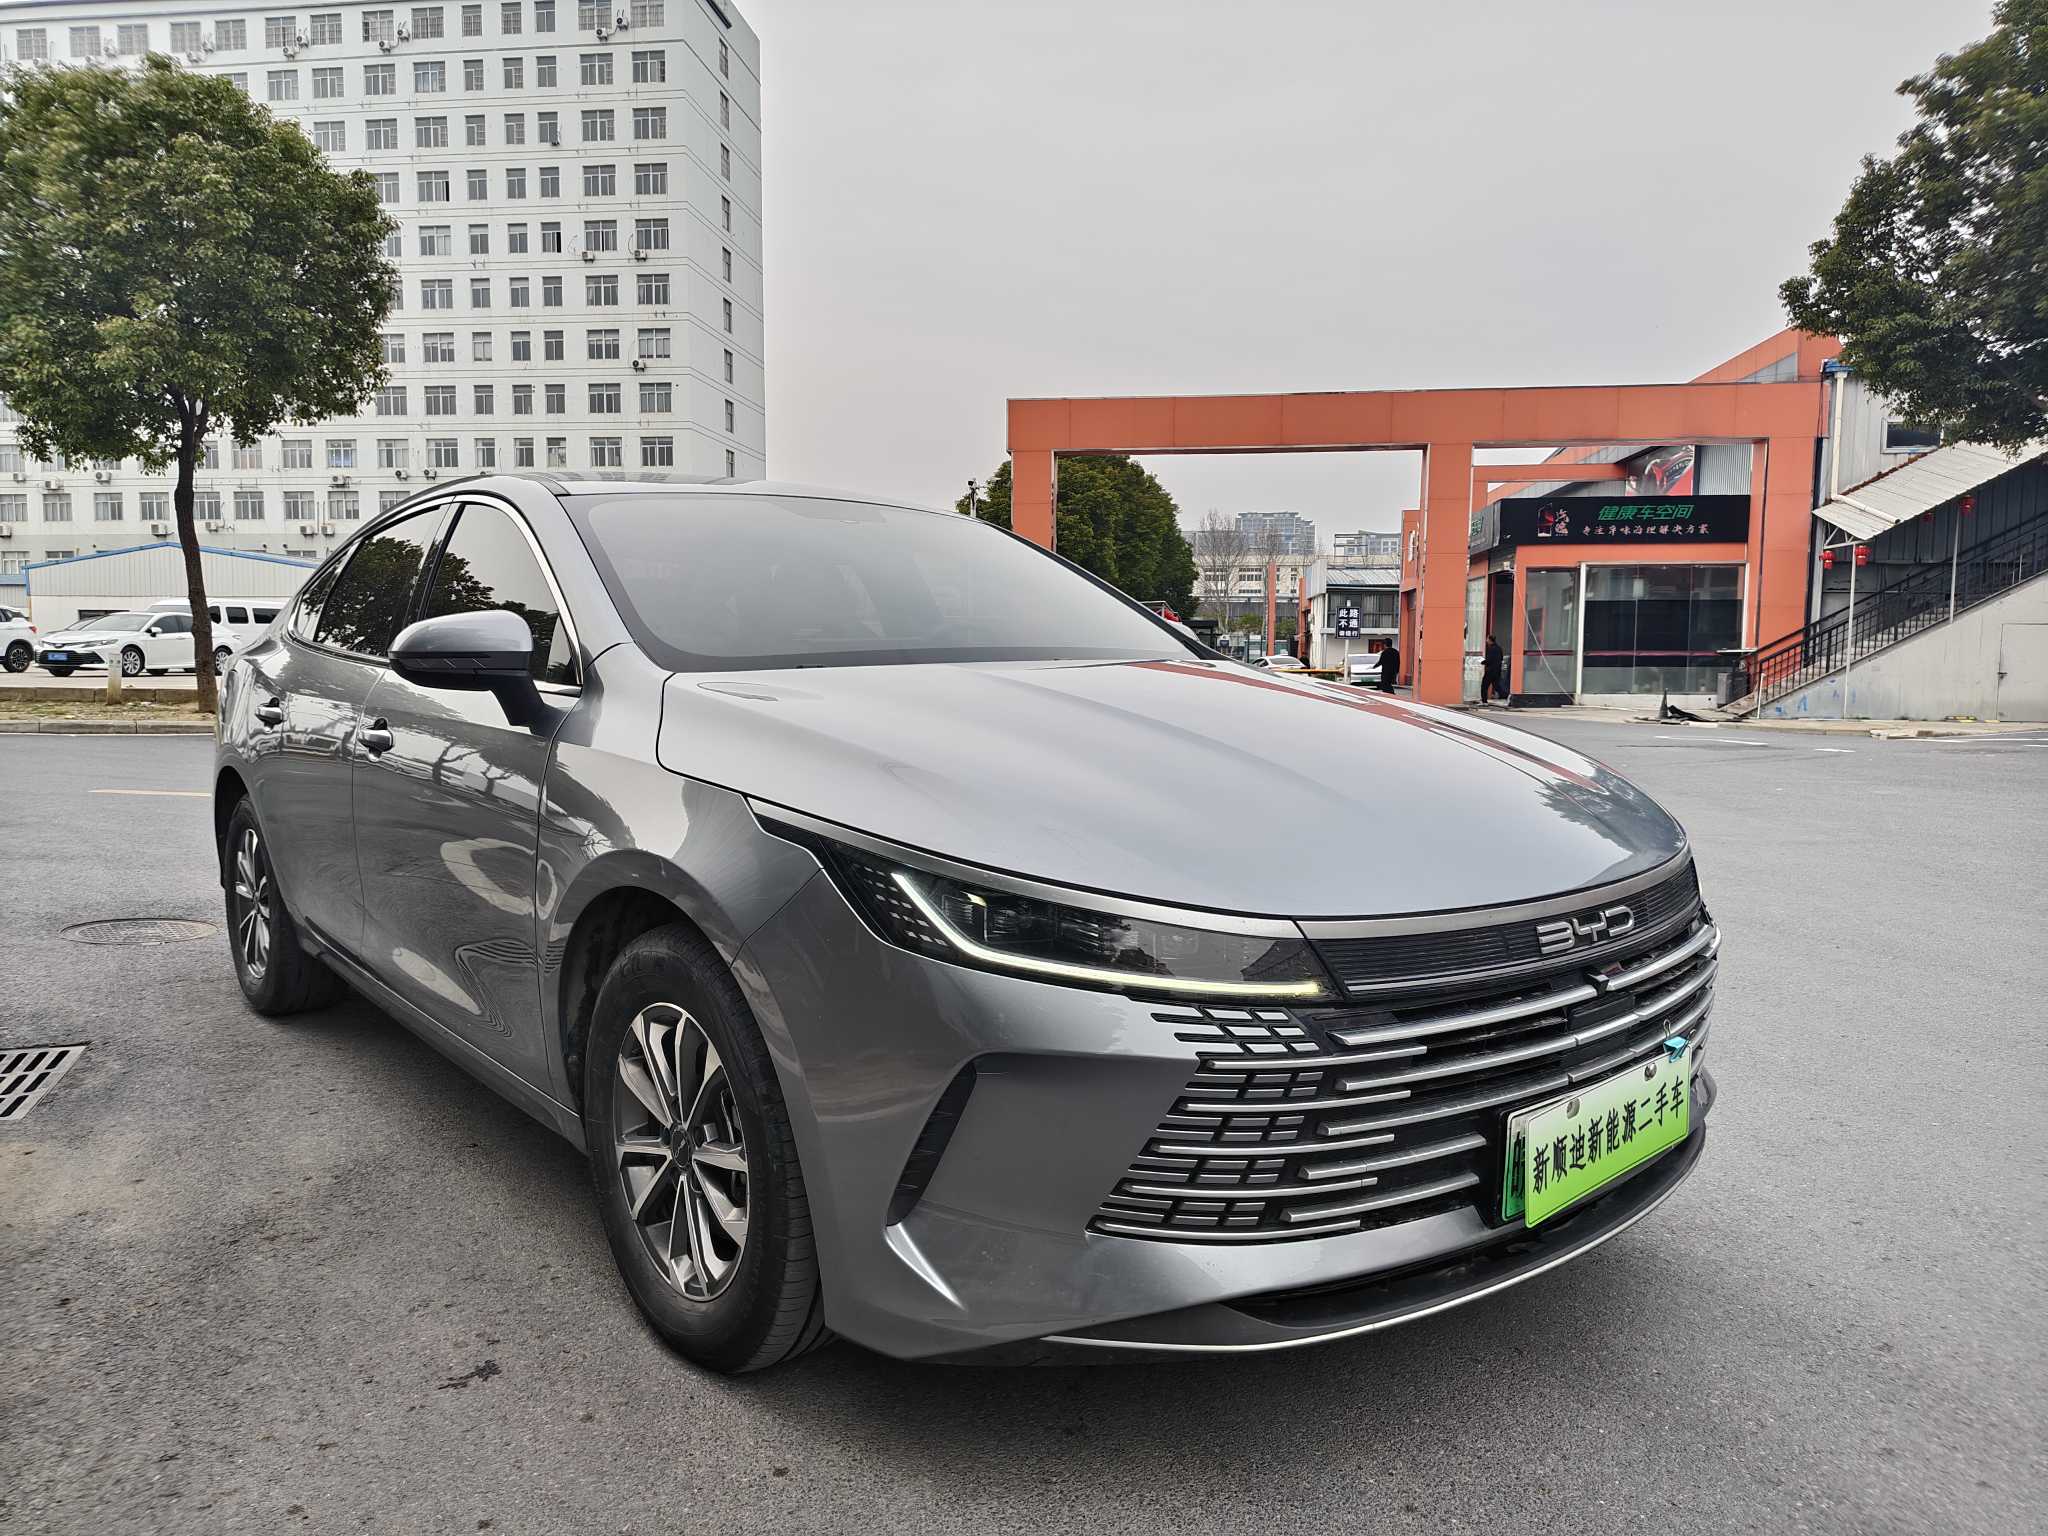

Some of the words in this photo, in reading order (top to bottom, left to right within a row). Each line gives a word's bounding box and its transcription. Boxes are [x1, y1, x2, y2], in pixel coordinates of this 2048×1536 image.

[1598, 504, 1694, 521] 健康车空间
[1339, 608, 1359, 618] 此路
[1338, 618, 1359, 628] 不通
[1536, 905, 1635, 955] BYD
[1532, 1075, 1684, 1195] 新顺迪新能源二手车
